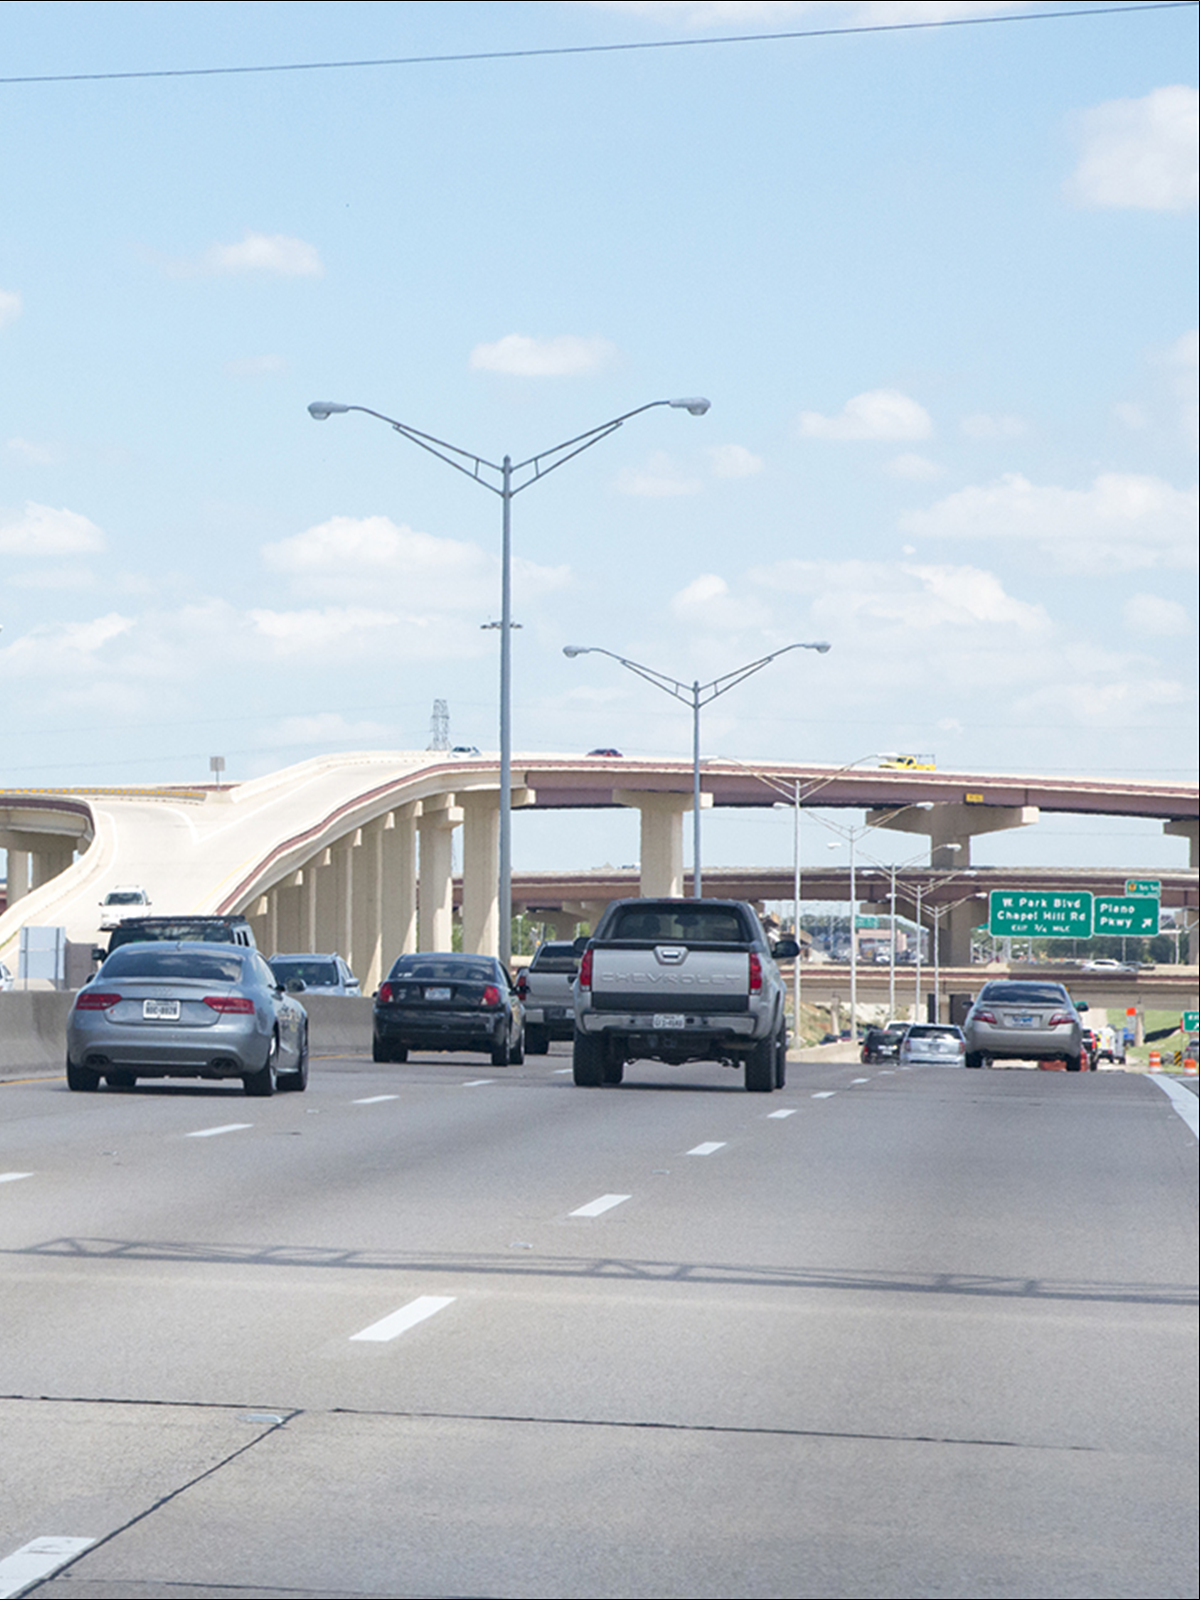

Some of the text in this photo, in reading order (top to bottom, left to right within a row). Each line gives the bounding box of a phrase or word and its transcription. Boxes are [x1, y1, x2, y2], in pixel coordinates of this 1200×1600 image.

[1019, 897, 1047, 907] Park
[1054, 898, 1081, 908] Blvd
[1100, 903, 1135, 913] Plano
[997, 910, 1086, 922] Chapel Hill Rd
[1100, 916, 1132, 928] Pkwy
[602, 972, 741, 985] CHEVROLET
